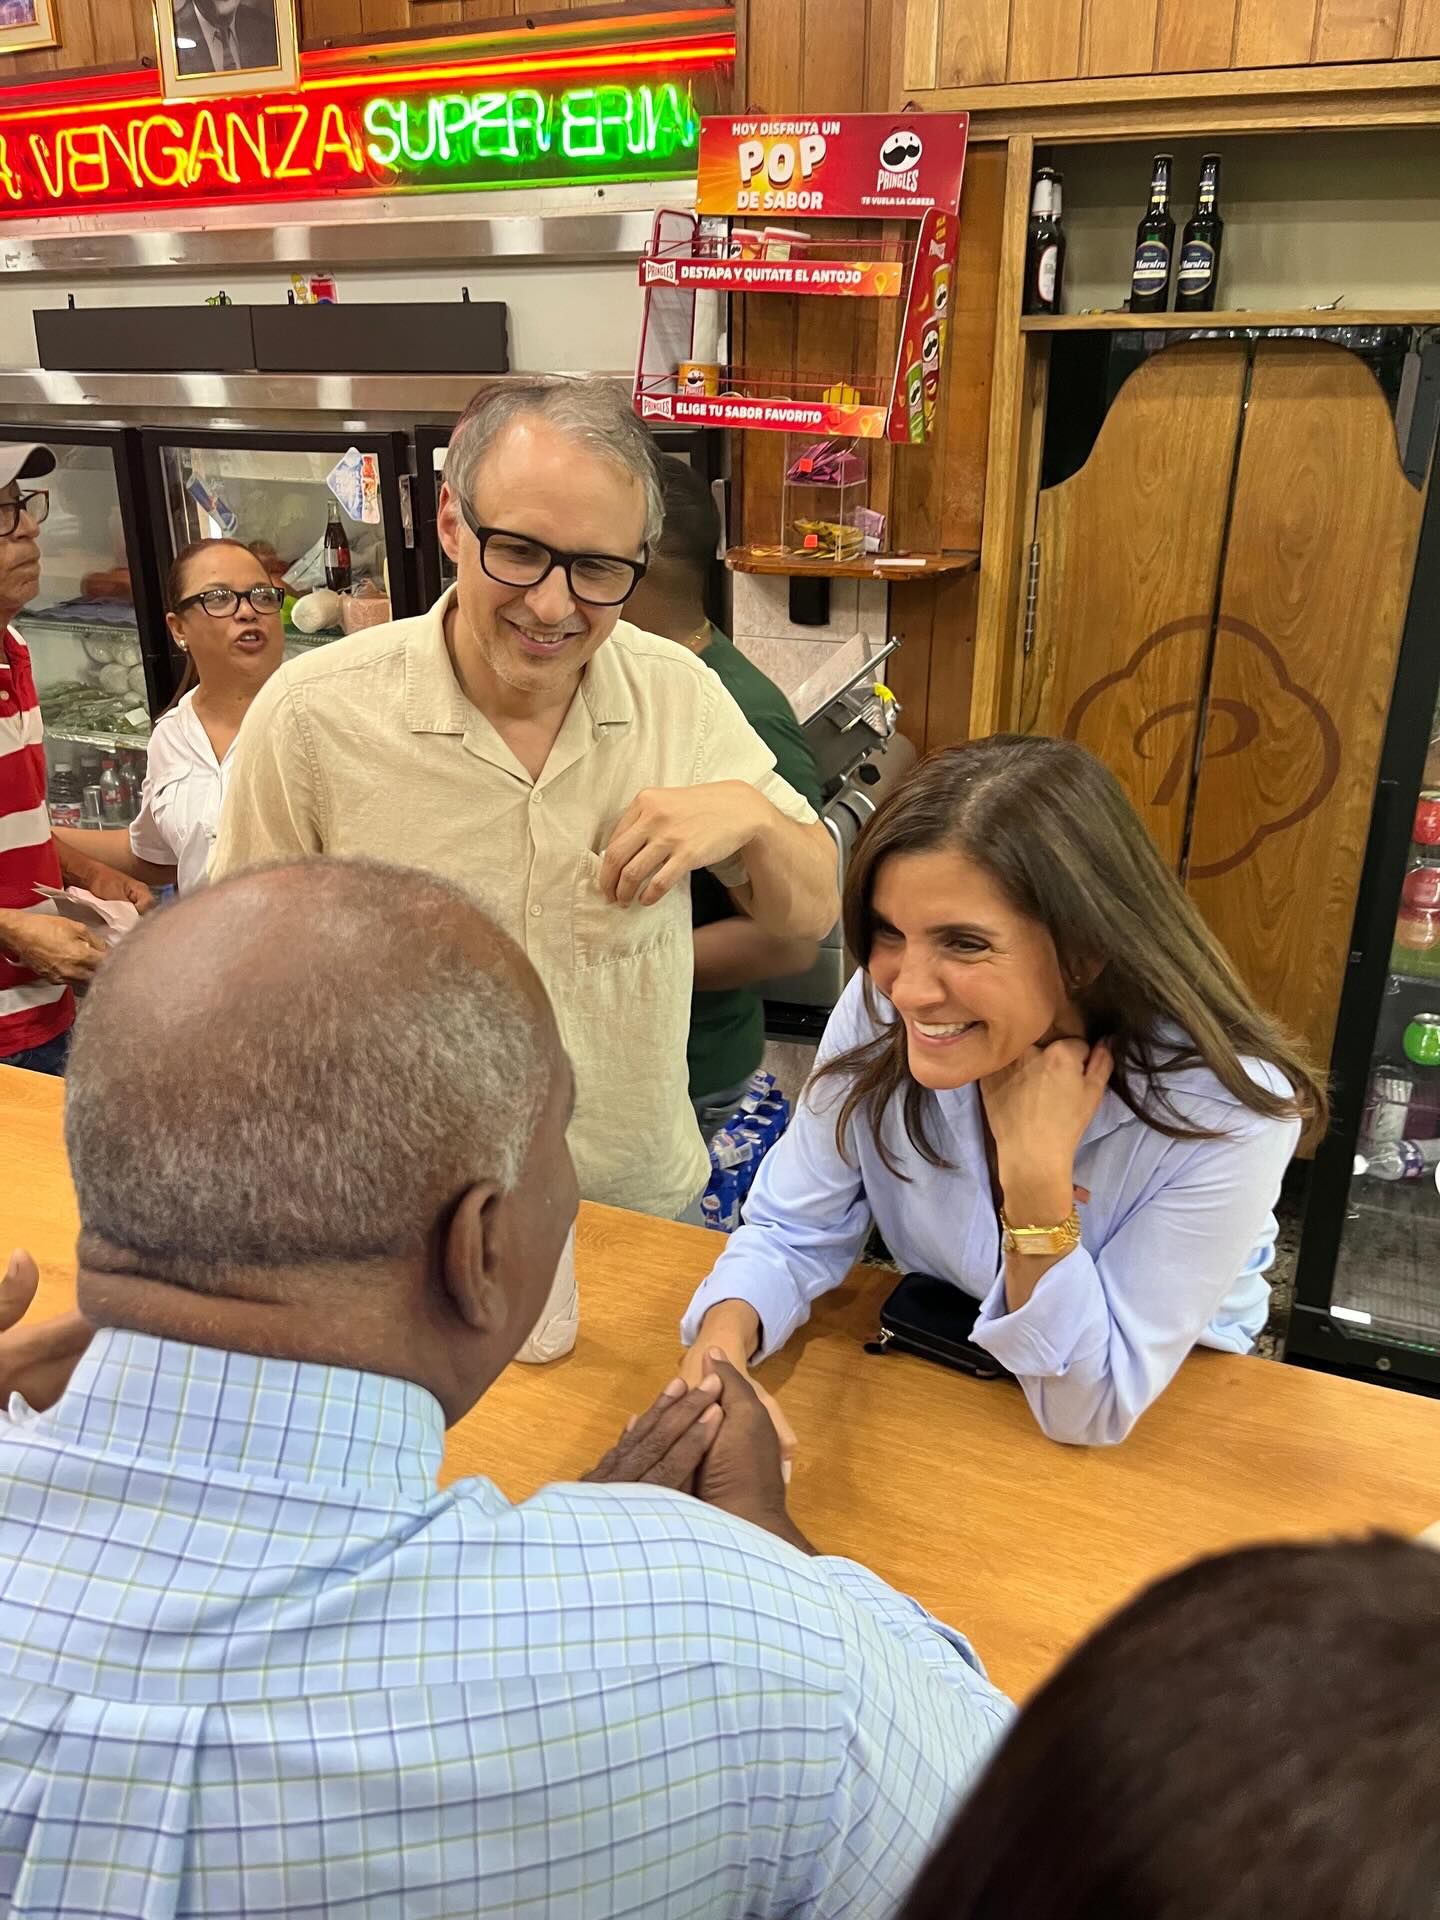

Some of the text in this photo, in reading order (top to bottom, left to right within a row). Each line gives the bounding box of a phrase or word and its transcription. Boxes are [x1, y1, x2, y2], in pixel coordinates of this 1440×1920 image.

[364, 87, 552, 164] SUPER
[732, 121, 841, 136] HOY DISFRUTA UN
[29, 104, 361, 197] VENGANZA
[738, 135, 826, 188] POP
[877, 169, 919, 193] PRINGLES
[737, 191, 824, 210] DE SABOR
[647, 263, 674, 280] PRINGLES
[681, 265, 862, 284] DESTAPA Y QUITATE EL ANTOJO
[643, 399, 671, 416] PRINGLES
[676, 402, 823, 424] ELIGE TU SABOR FAVORITO
